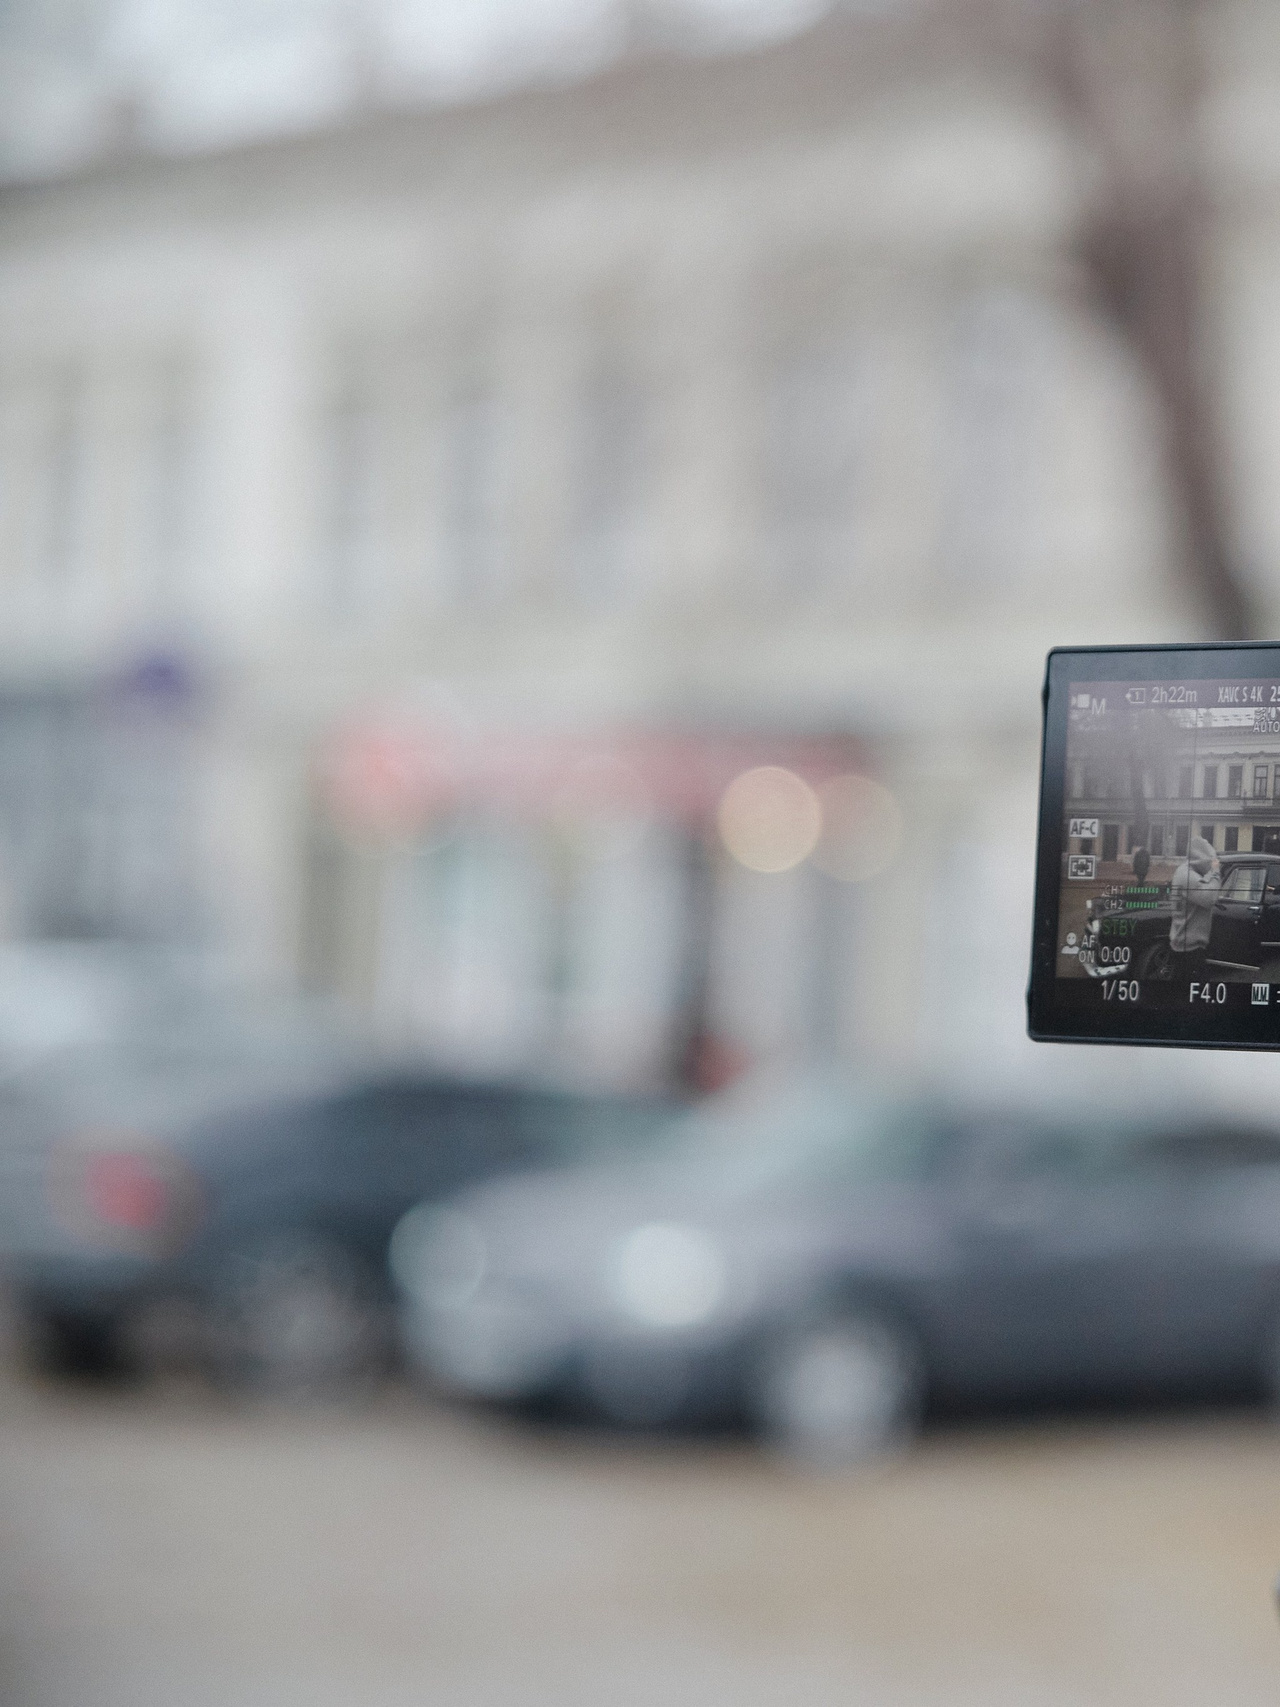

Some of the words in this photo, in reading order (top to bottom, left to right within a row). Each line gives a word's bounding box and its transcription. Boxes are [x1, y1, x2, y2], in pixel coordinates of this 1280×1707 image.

[1151, 686, 1198, 702] 2h22m
[1218, 686, 1240, 702] XAVC
[1250, 686, 1263, 702] 4K
[1092, 698, 1106, 715] M
[1253, 721, 1280, 733] AUTO
[1070, 820, 1097, 836] AF-C
[1104, 885, 1123, 895] CH1
[1104, 899, 1123, 910] CH2
[1103, 919, 1138, 935] STBY
[1081, 935, 1096, 948] AF
[1079, 950, 1095, 963] ON
[1101, 946, 1131, 963] 0:00
[1101, 980, 1140, 1001] 1/50
[1189, 982, 1226, 1004] F4.0
